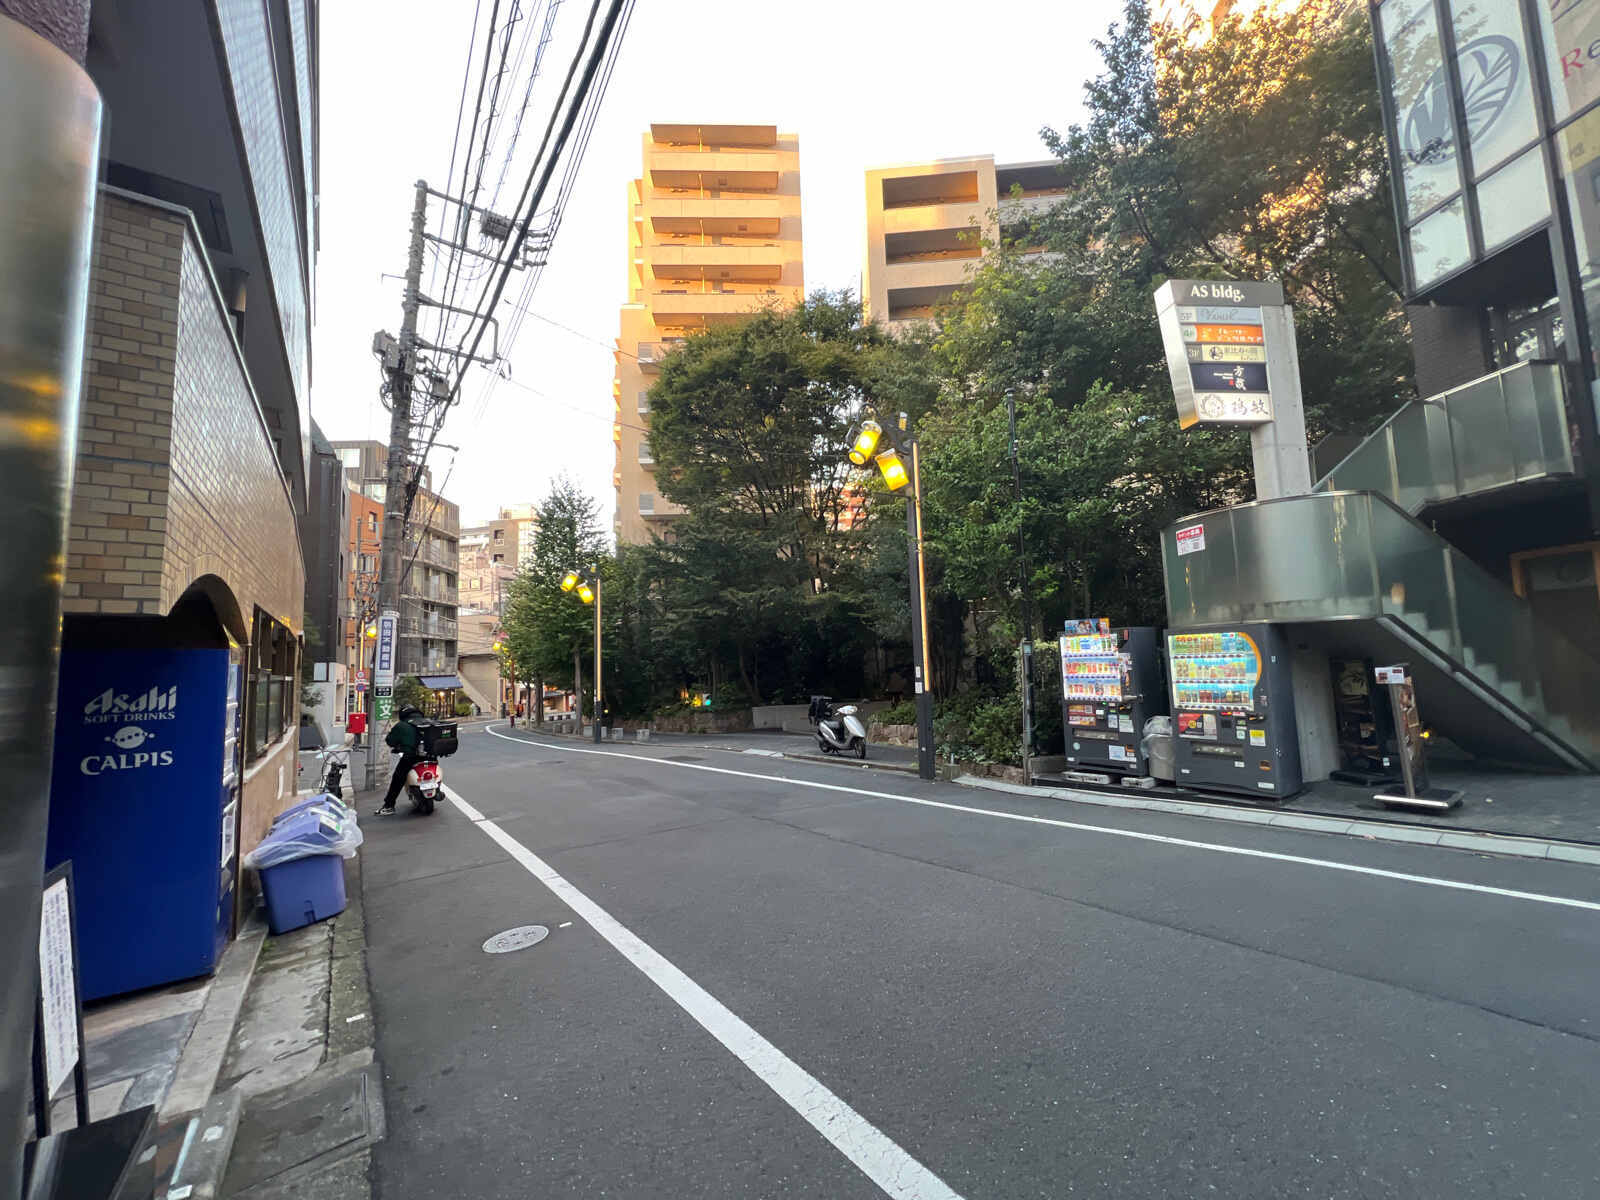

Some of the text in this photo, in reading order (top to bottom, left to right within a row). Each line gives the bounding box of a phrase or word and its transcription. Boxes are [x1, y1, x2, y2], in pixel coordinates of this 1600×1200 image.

[1191, 284, 1245, 303] AS bldg.
[84, 685, 177, 714] Asahi
[84, 711, 176, 723] SOFT DRINKS
[80, 751, 174, 775] CALPIS
